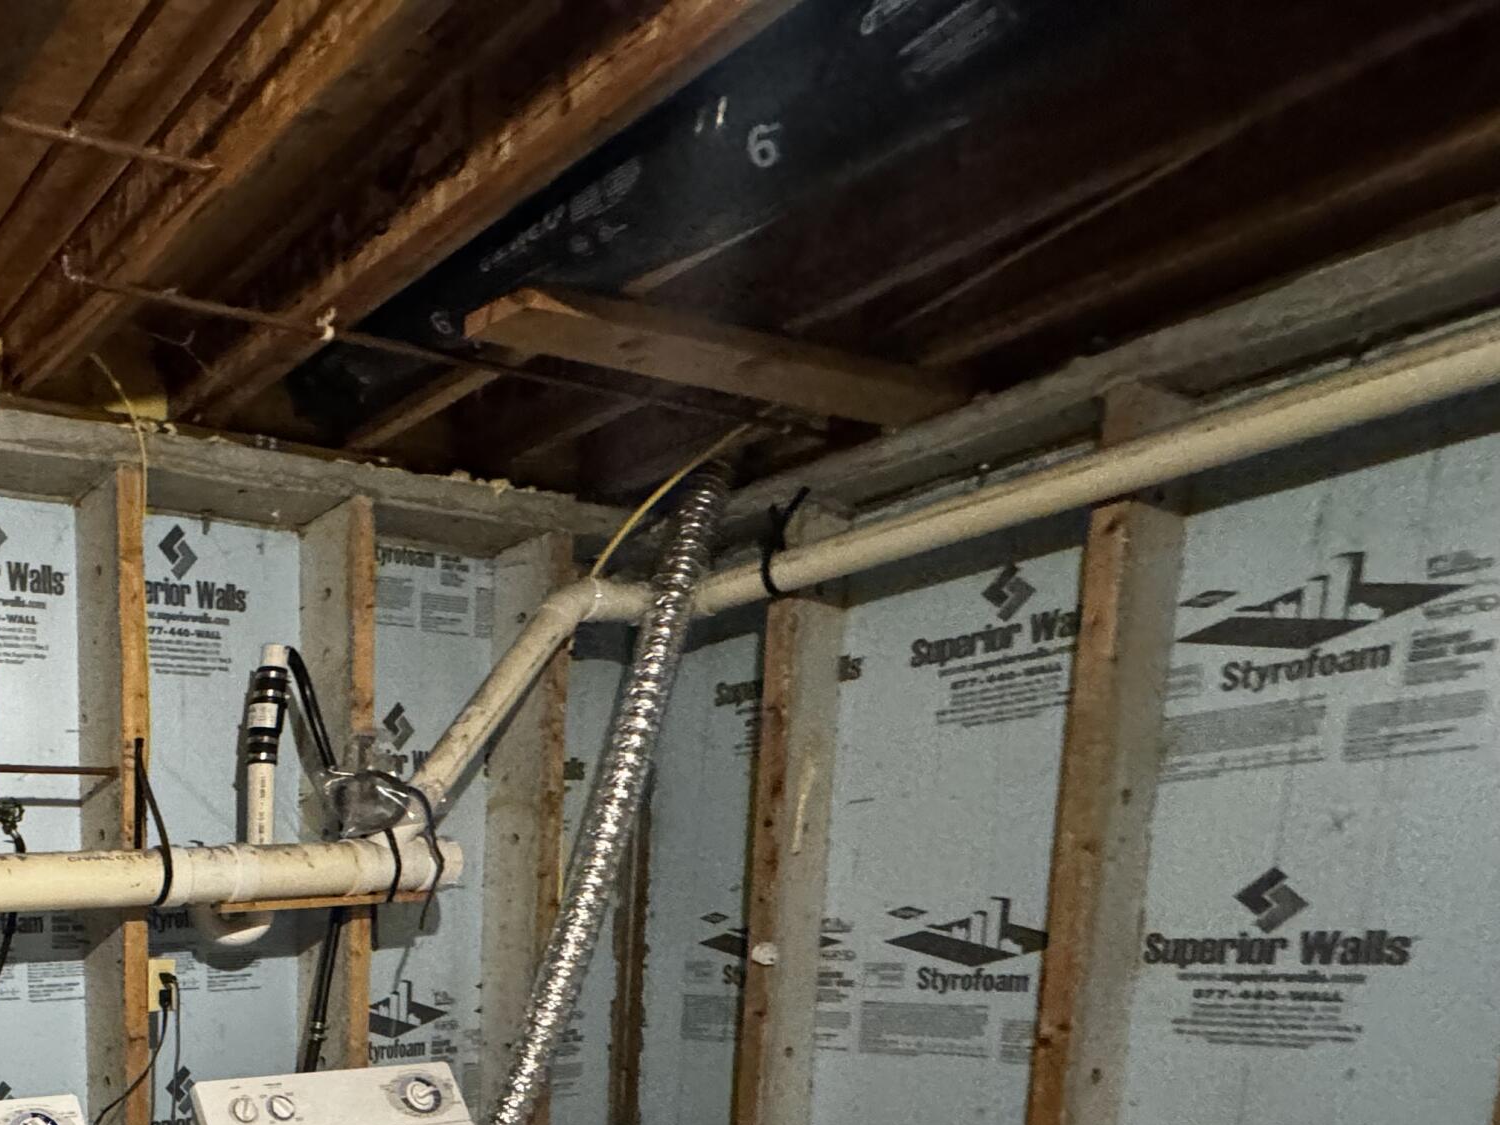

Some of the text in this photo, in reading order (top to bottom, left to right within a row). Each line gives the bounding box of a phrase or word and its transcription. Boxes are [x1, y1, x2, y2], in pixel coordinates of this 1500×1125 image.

[145, 577, 247, 612] erior Walls
[911, 623, 1022, 668] Superior
[1220, 644, 1392, 693] Styrofoam
[1143, 930, 1411, 969] Superior Walls
[916, 966, 1030, 994] Styrofoam
[368, 1041, 425, 1062] tyrofoam
